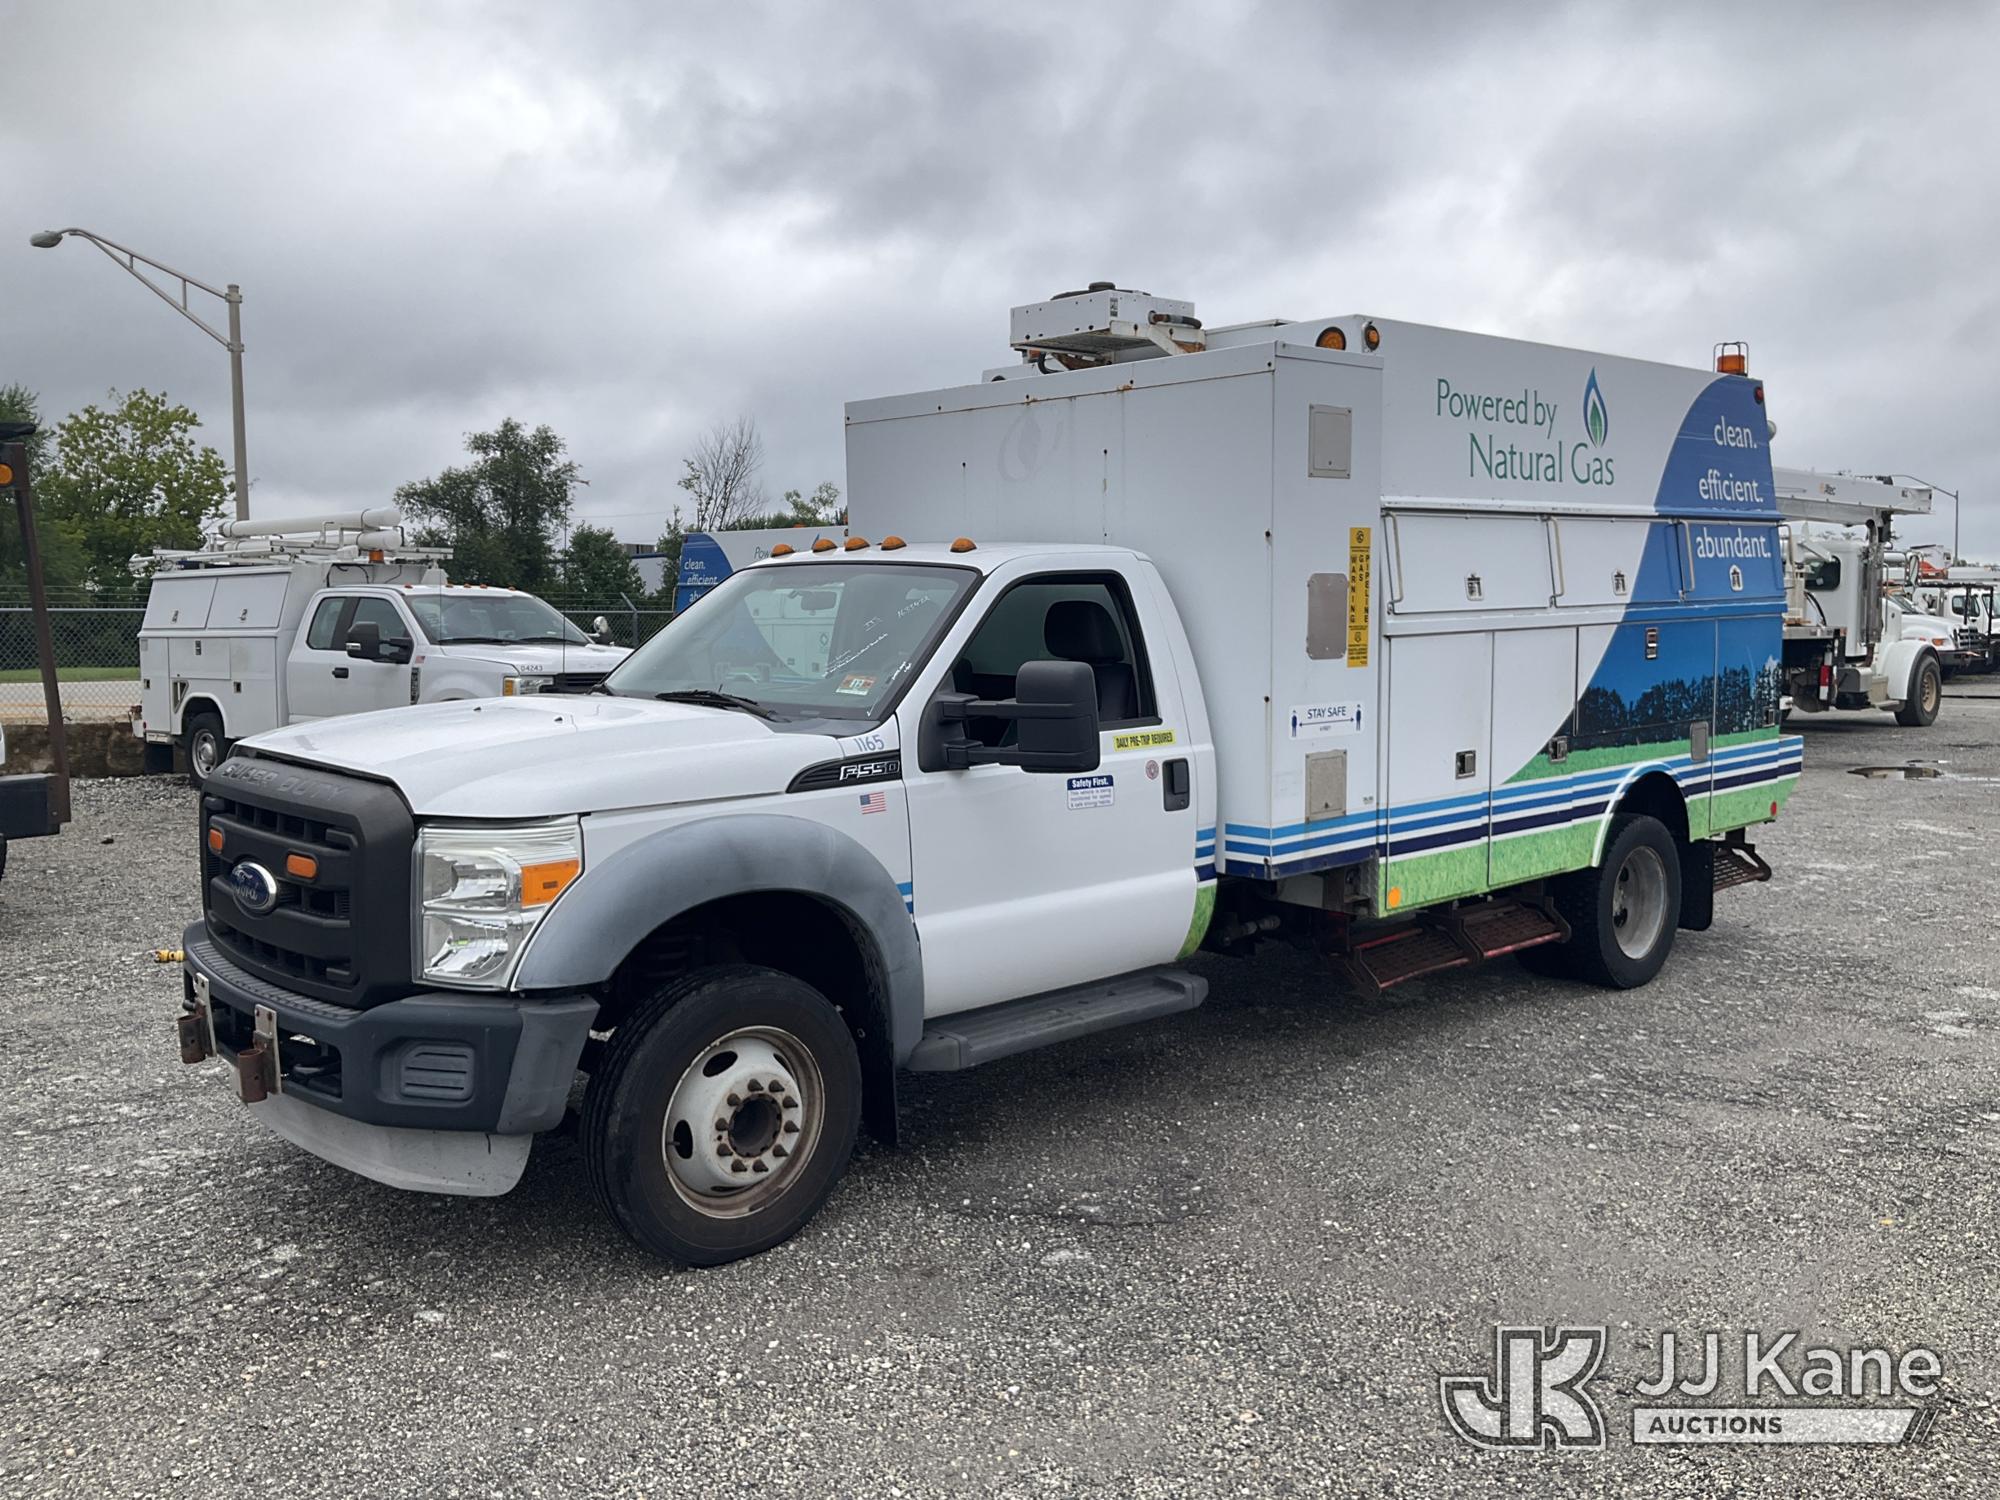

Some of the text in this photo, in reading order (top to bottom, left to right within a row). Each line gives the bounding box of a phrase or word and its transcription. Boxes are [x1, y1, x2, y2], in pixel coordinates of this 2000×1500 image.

[1436, 378, 1557, 439] Powered by
[1714, 415, 1757, 448] clean.
[1469, 432, 1615, 485] Natural Gas
[1699, 469, 1763, 503] efficient.
[1696, 527, 1771, 558] abundant.
[684, 558, 706, 570] clean.
[1307, 706, 1346, 719] STAY SAFE
[854, 734, 885, 752] 1165
[1115, 737, 1128, 749] DAILY
[1151, 732, 1173, 745] REQUIRED
[276, 776, 350, 800] DUTY
[1072, 777, 1109, 788] Safety First.
